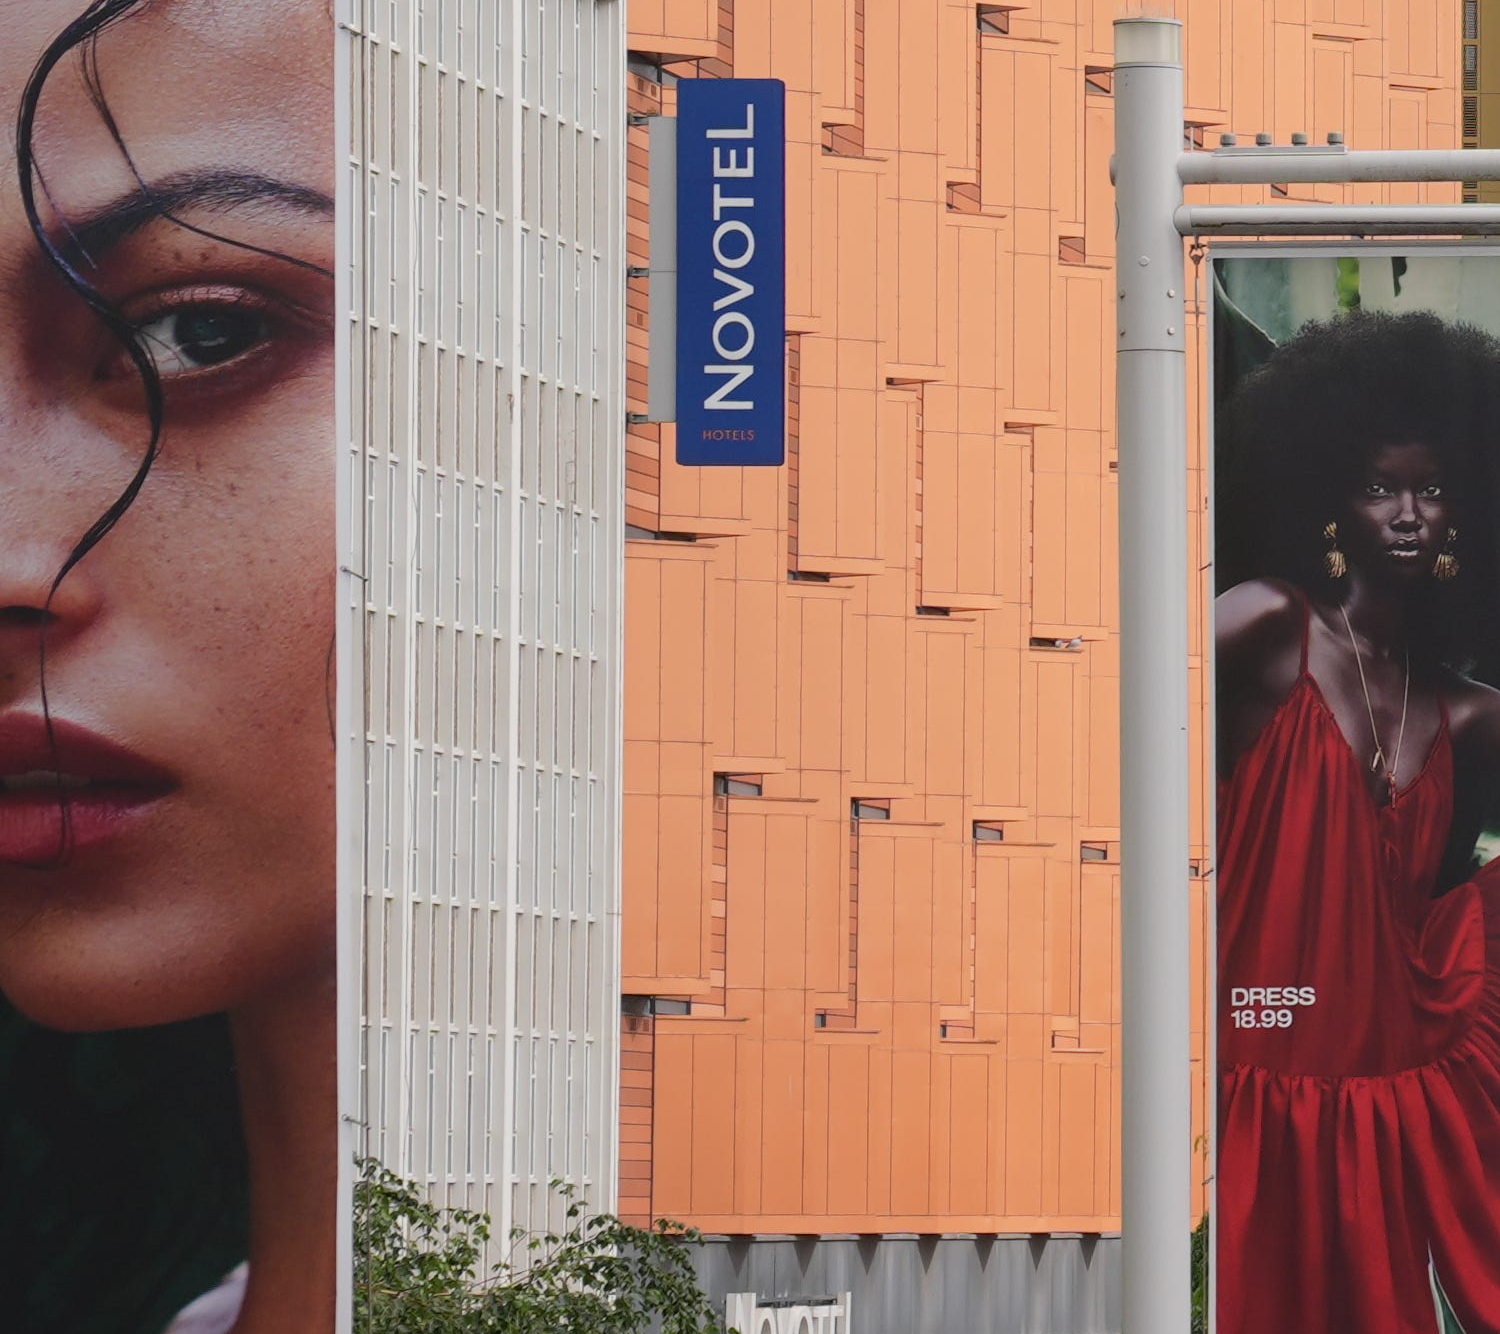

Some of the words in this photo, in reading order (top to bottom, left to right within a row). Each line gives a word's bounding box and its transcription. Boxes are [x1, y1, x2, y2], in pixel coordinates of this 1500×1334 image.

[703, 103, 756, 411] NOVOTEL
[703, 429, 755, 441] HOTELS
[1230, 987, 1316, 1007] DRESS
[1230, 1009, 1293, 1029] 18.99
